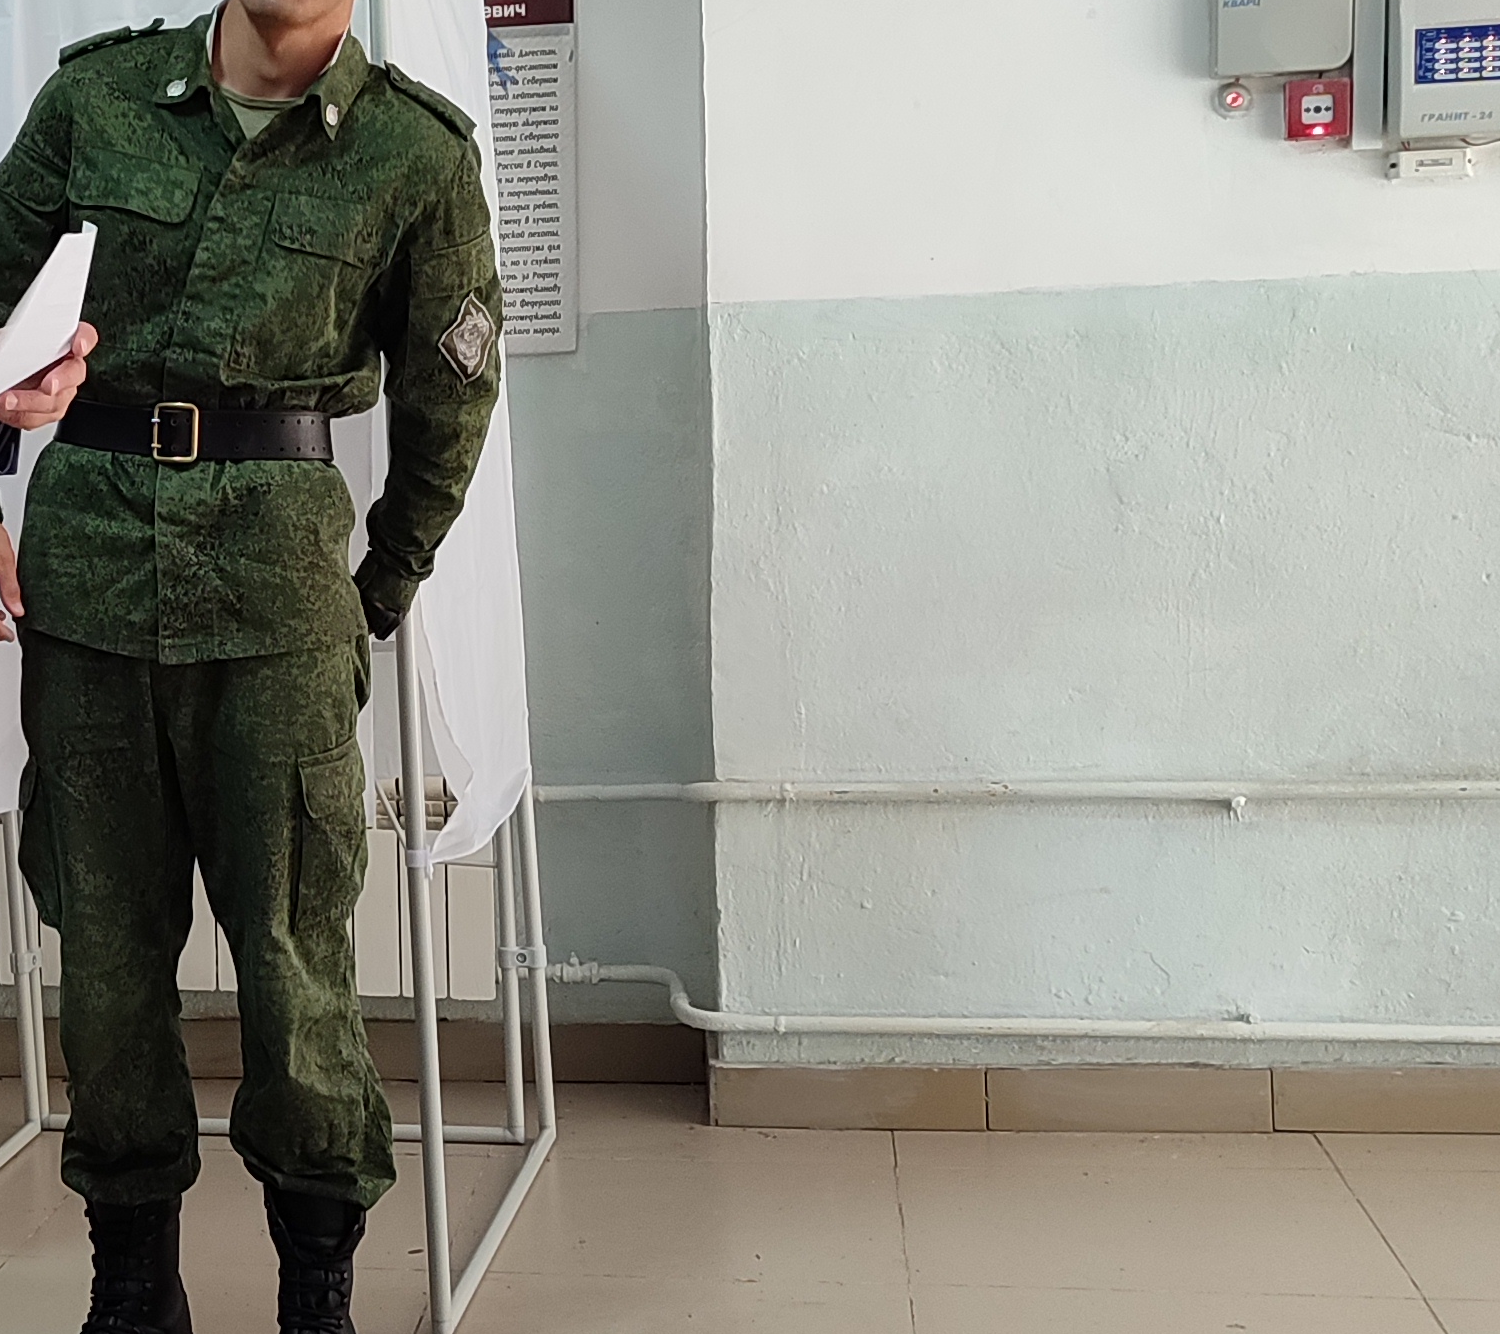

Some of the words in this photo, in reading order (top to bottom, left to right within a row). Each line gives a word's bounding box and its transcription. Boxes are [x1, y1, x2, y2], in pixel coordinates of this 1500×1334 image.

[484, 3, 526, 19] евич
[522, 75, 559, 87] Северном
[520, 131, 560, 143] Северного
